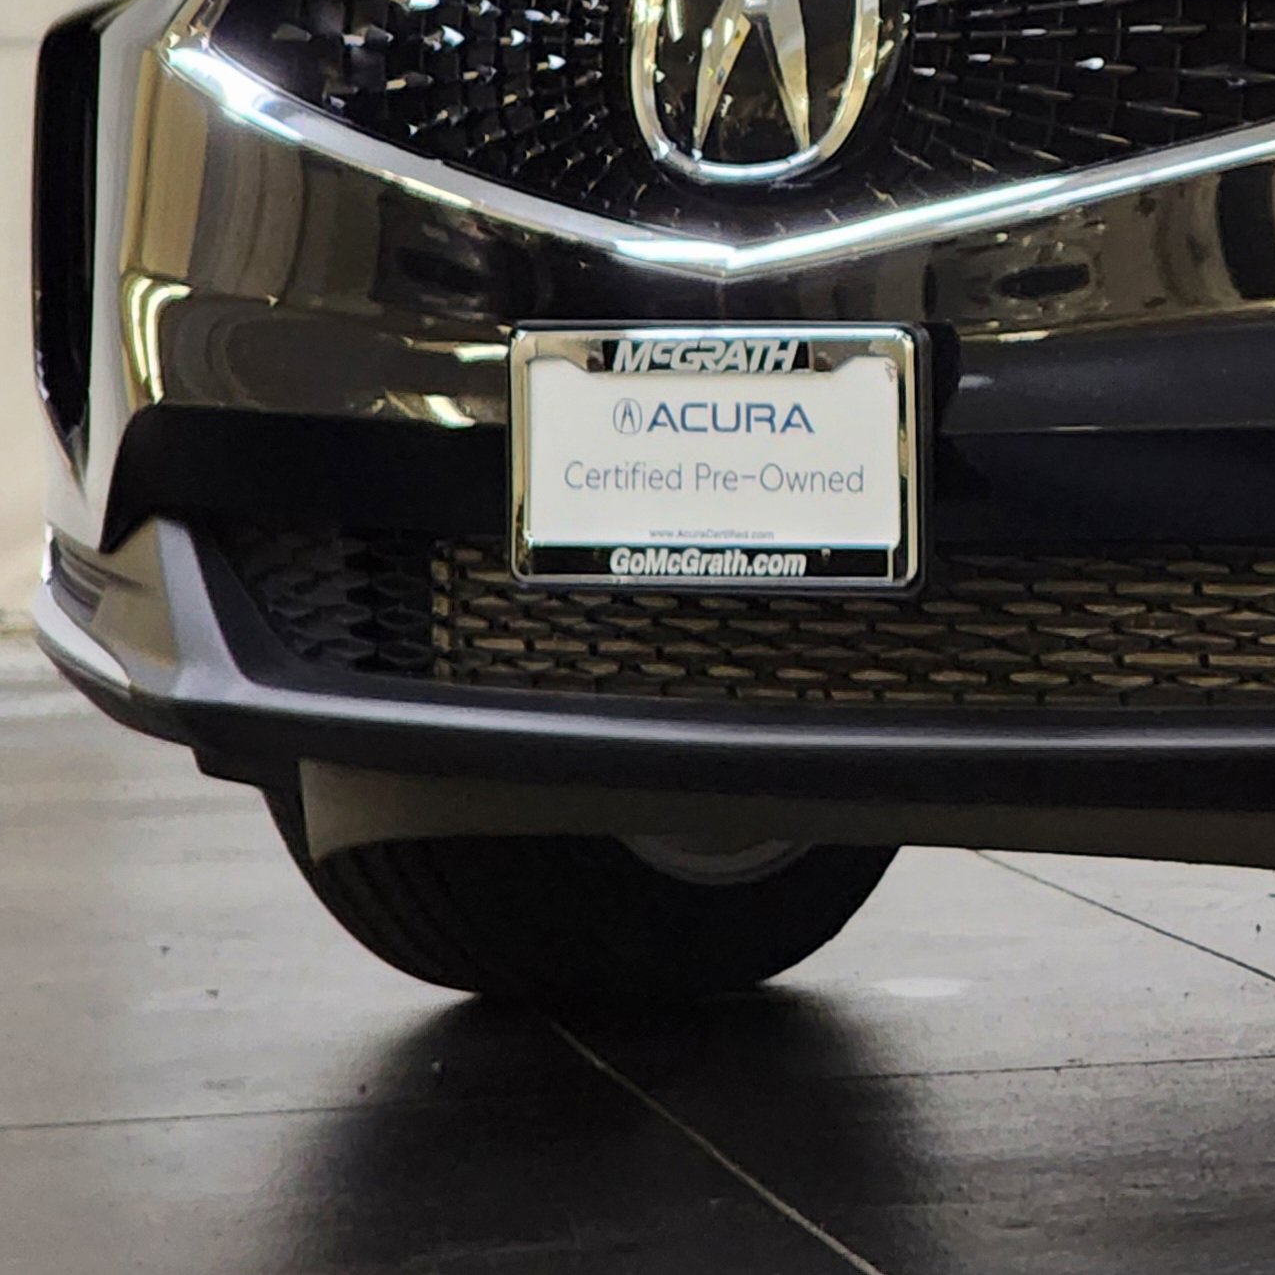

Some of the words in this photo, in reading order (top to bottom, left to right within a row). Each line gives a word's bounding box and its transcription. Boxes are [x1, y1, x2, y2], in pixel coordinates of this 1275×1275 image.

[647, 402, 815, 434] ACURA
[564, 461, 683, 491] Certified
[696, 463, 865, 493] Pre-Owned
[610, 547, 807, 577] GoMcGrath.com
